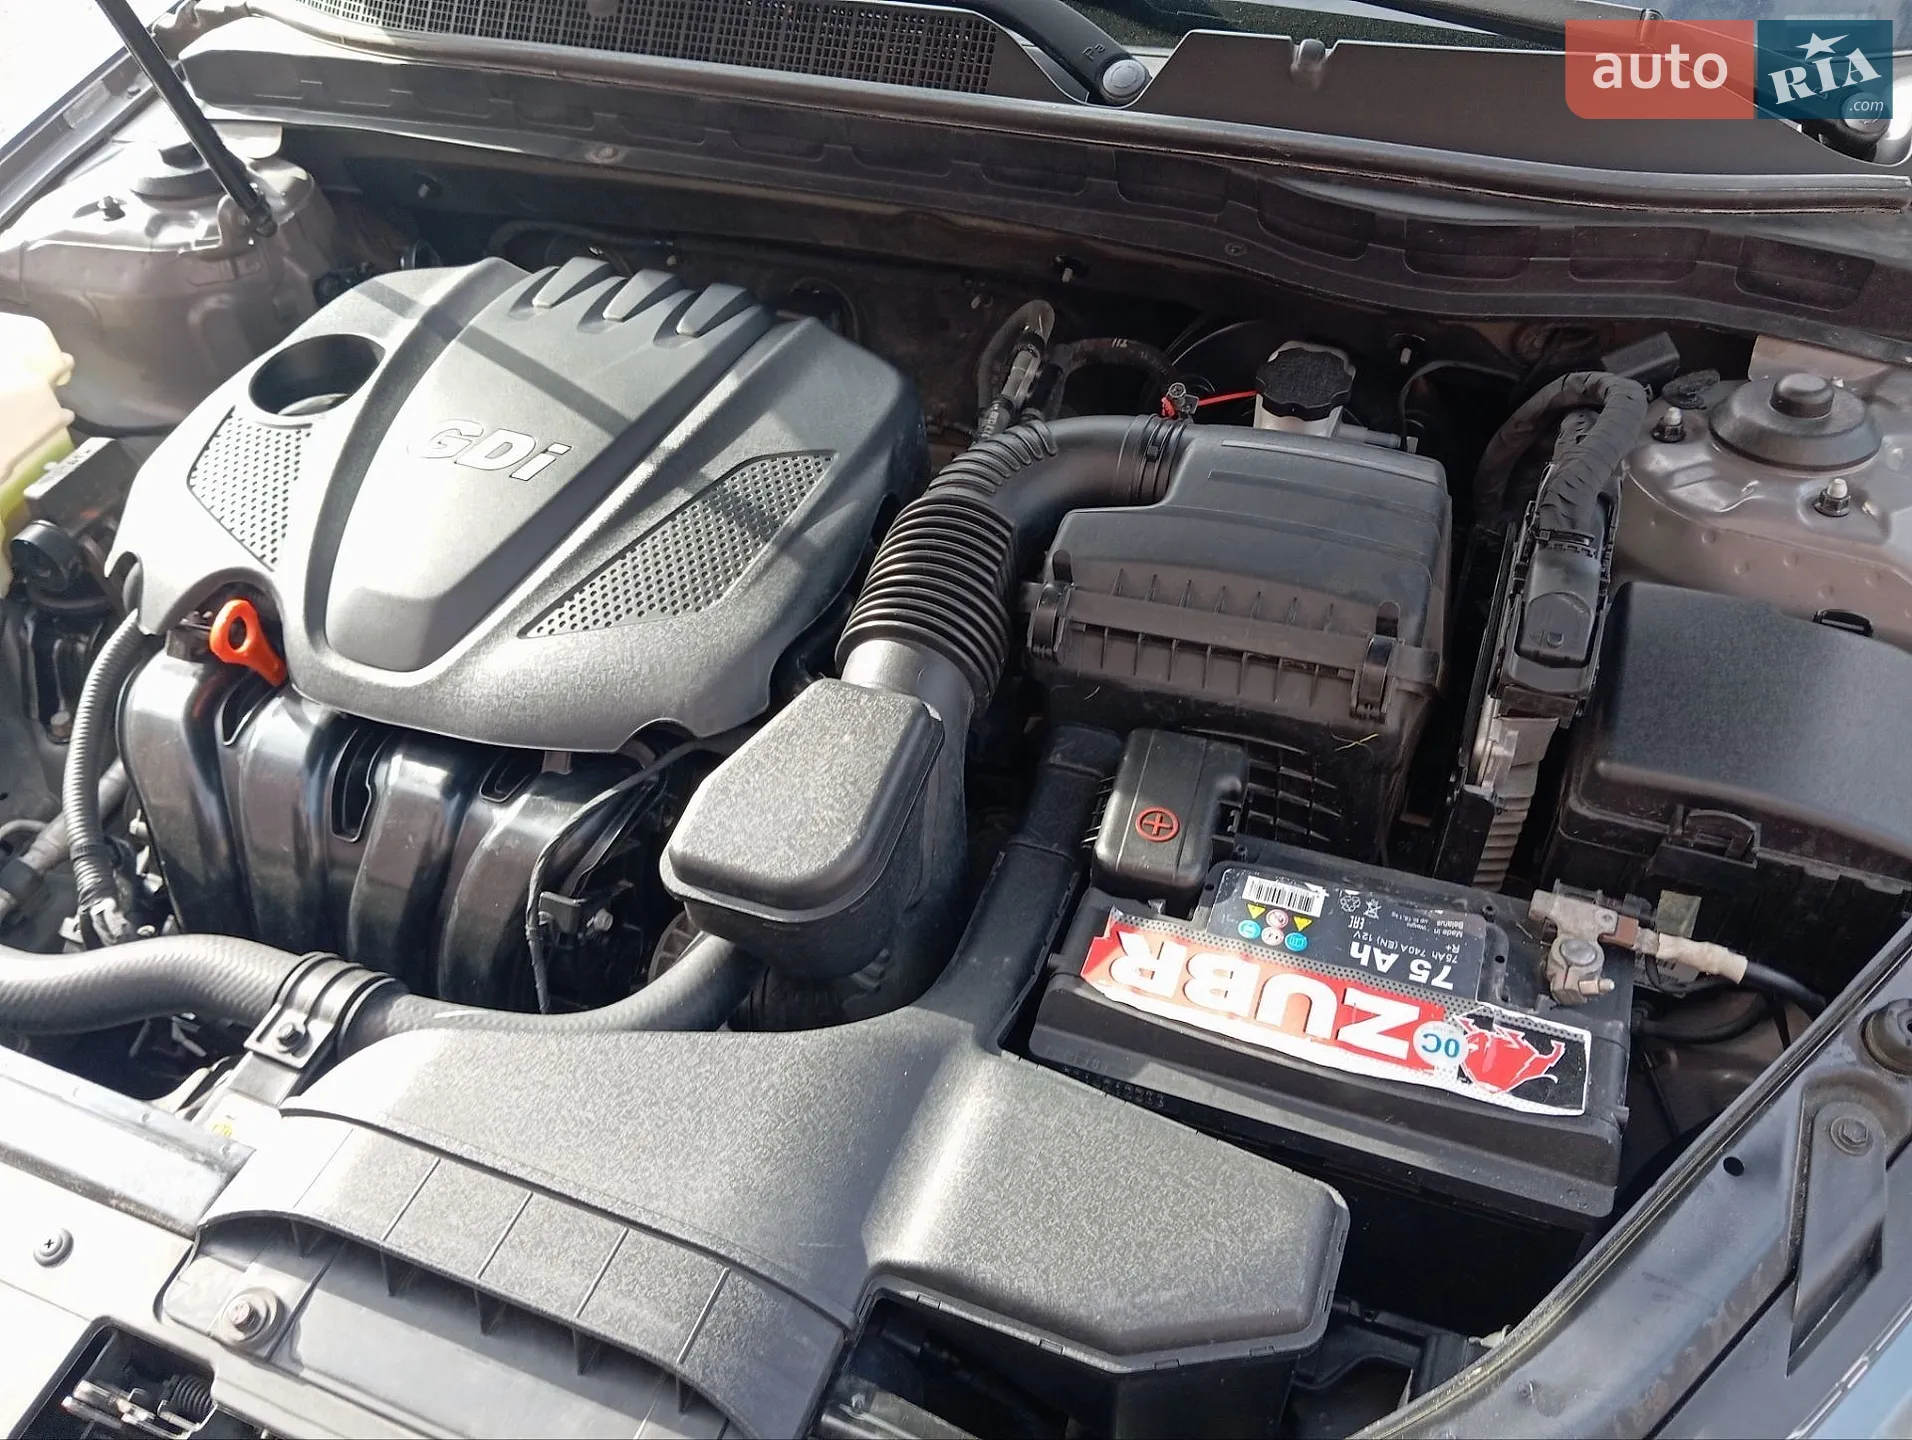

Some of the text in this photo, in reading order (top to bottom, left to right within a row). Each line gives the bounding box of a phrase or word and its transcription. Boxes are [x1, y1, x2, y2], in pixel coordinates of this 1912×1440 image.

[407, 418, 573, 482] GDi
[1433, 927, 1463, 938] Made in
[1436, 920, 1464, 930] Belarus
[1353, 930, 1458, 964] 75Ah 740A (EN) 12V
[1445, 944, 1460, 953] R+
[1350, 941, 1454, 991] 75 Ah
[1109, 930, 1420, 1059] ZUBR
